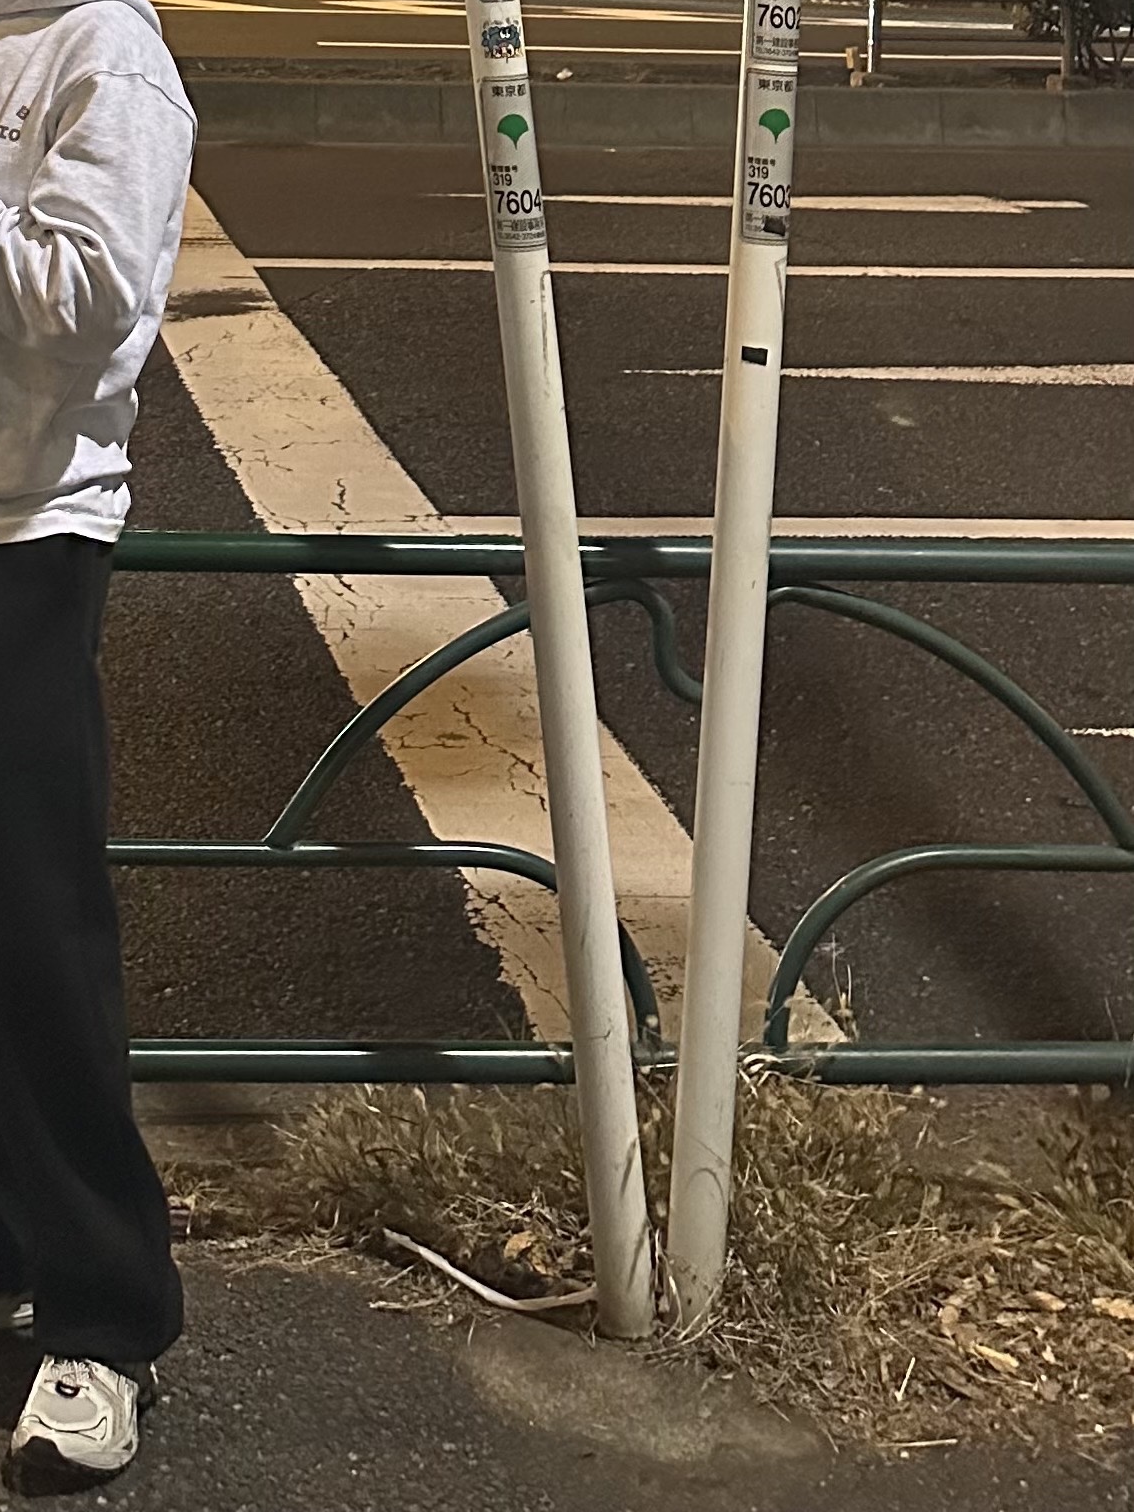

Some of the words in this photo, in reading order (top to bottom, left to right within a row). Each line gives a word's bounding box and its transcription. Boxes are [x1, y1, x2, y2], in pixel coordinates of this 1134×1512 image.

[492, 172, 513, 186] 319
[748, 164, 770, 180] 319
[493, 188, 543, 215] 7604
